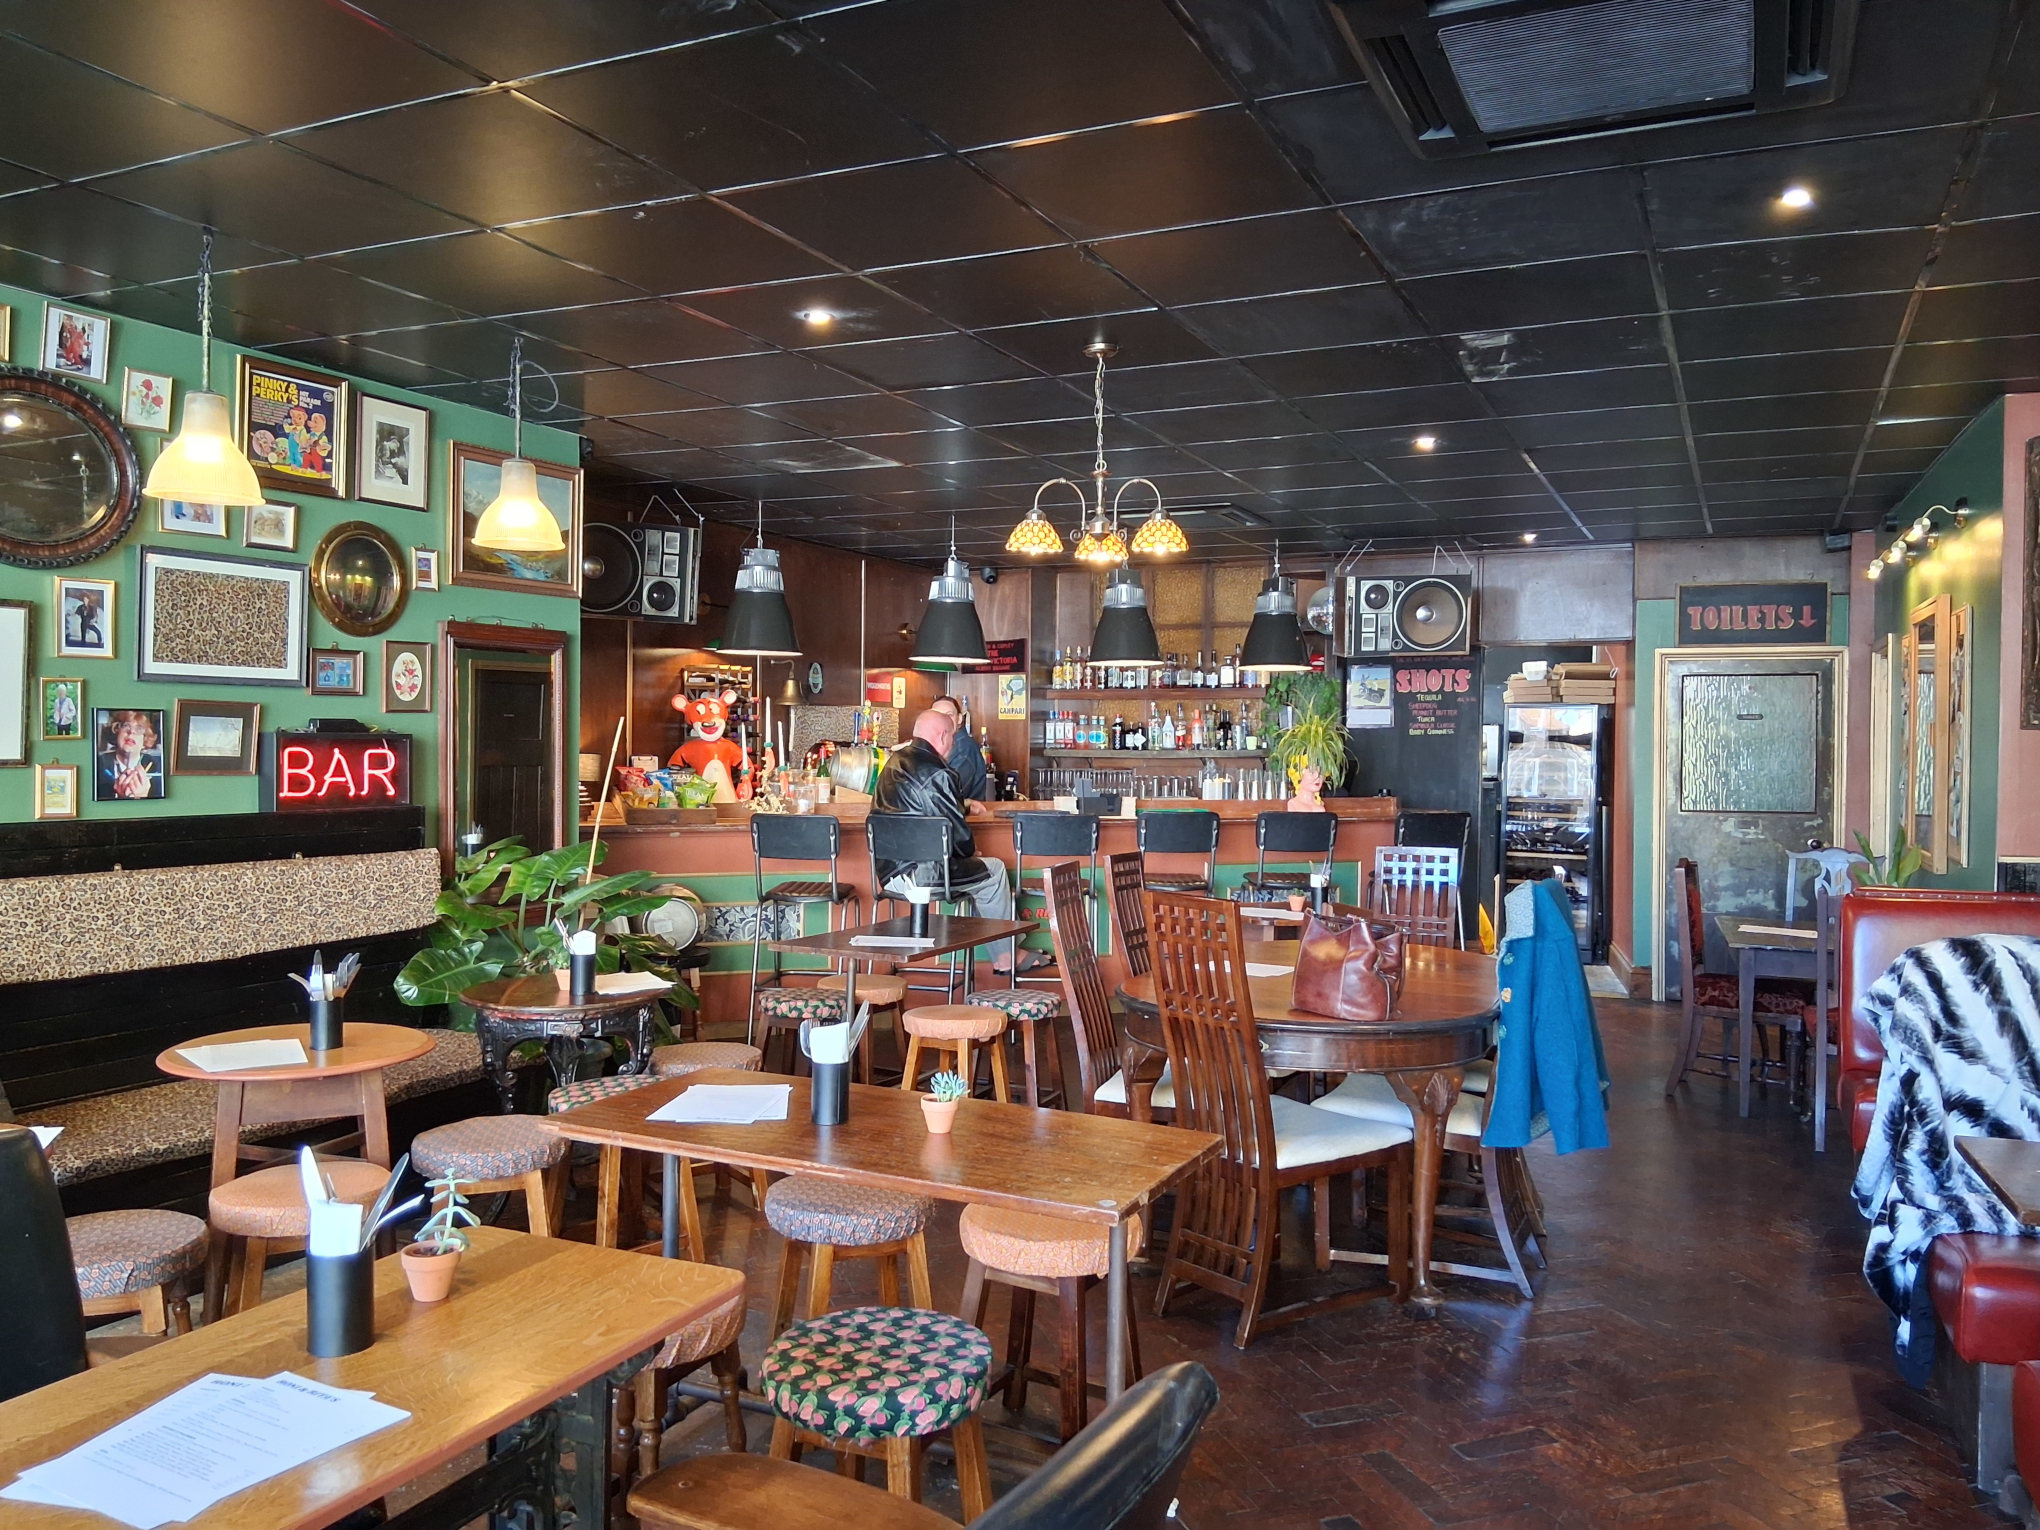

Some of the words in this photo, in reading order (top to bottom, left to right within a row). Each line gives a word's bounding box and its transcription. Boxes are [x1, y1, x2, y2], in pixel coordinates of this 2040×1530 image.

[253, 375, 287, 391] PINKY
[288, 384, 298, 393] &
[253, 386, 298, 405] PERKY'S
[1687, 604, 1795, 630] TOILETS
[1396, 669, 1471, 692] SHOTS
[1000, 708, 1025, 716] CAMPARI
[279, 746, 396, 797] BAR
